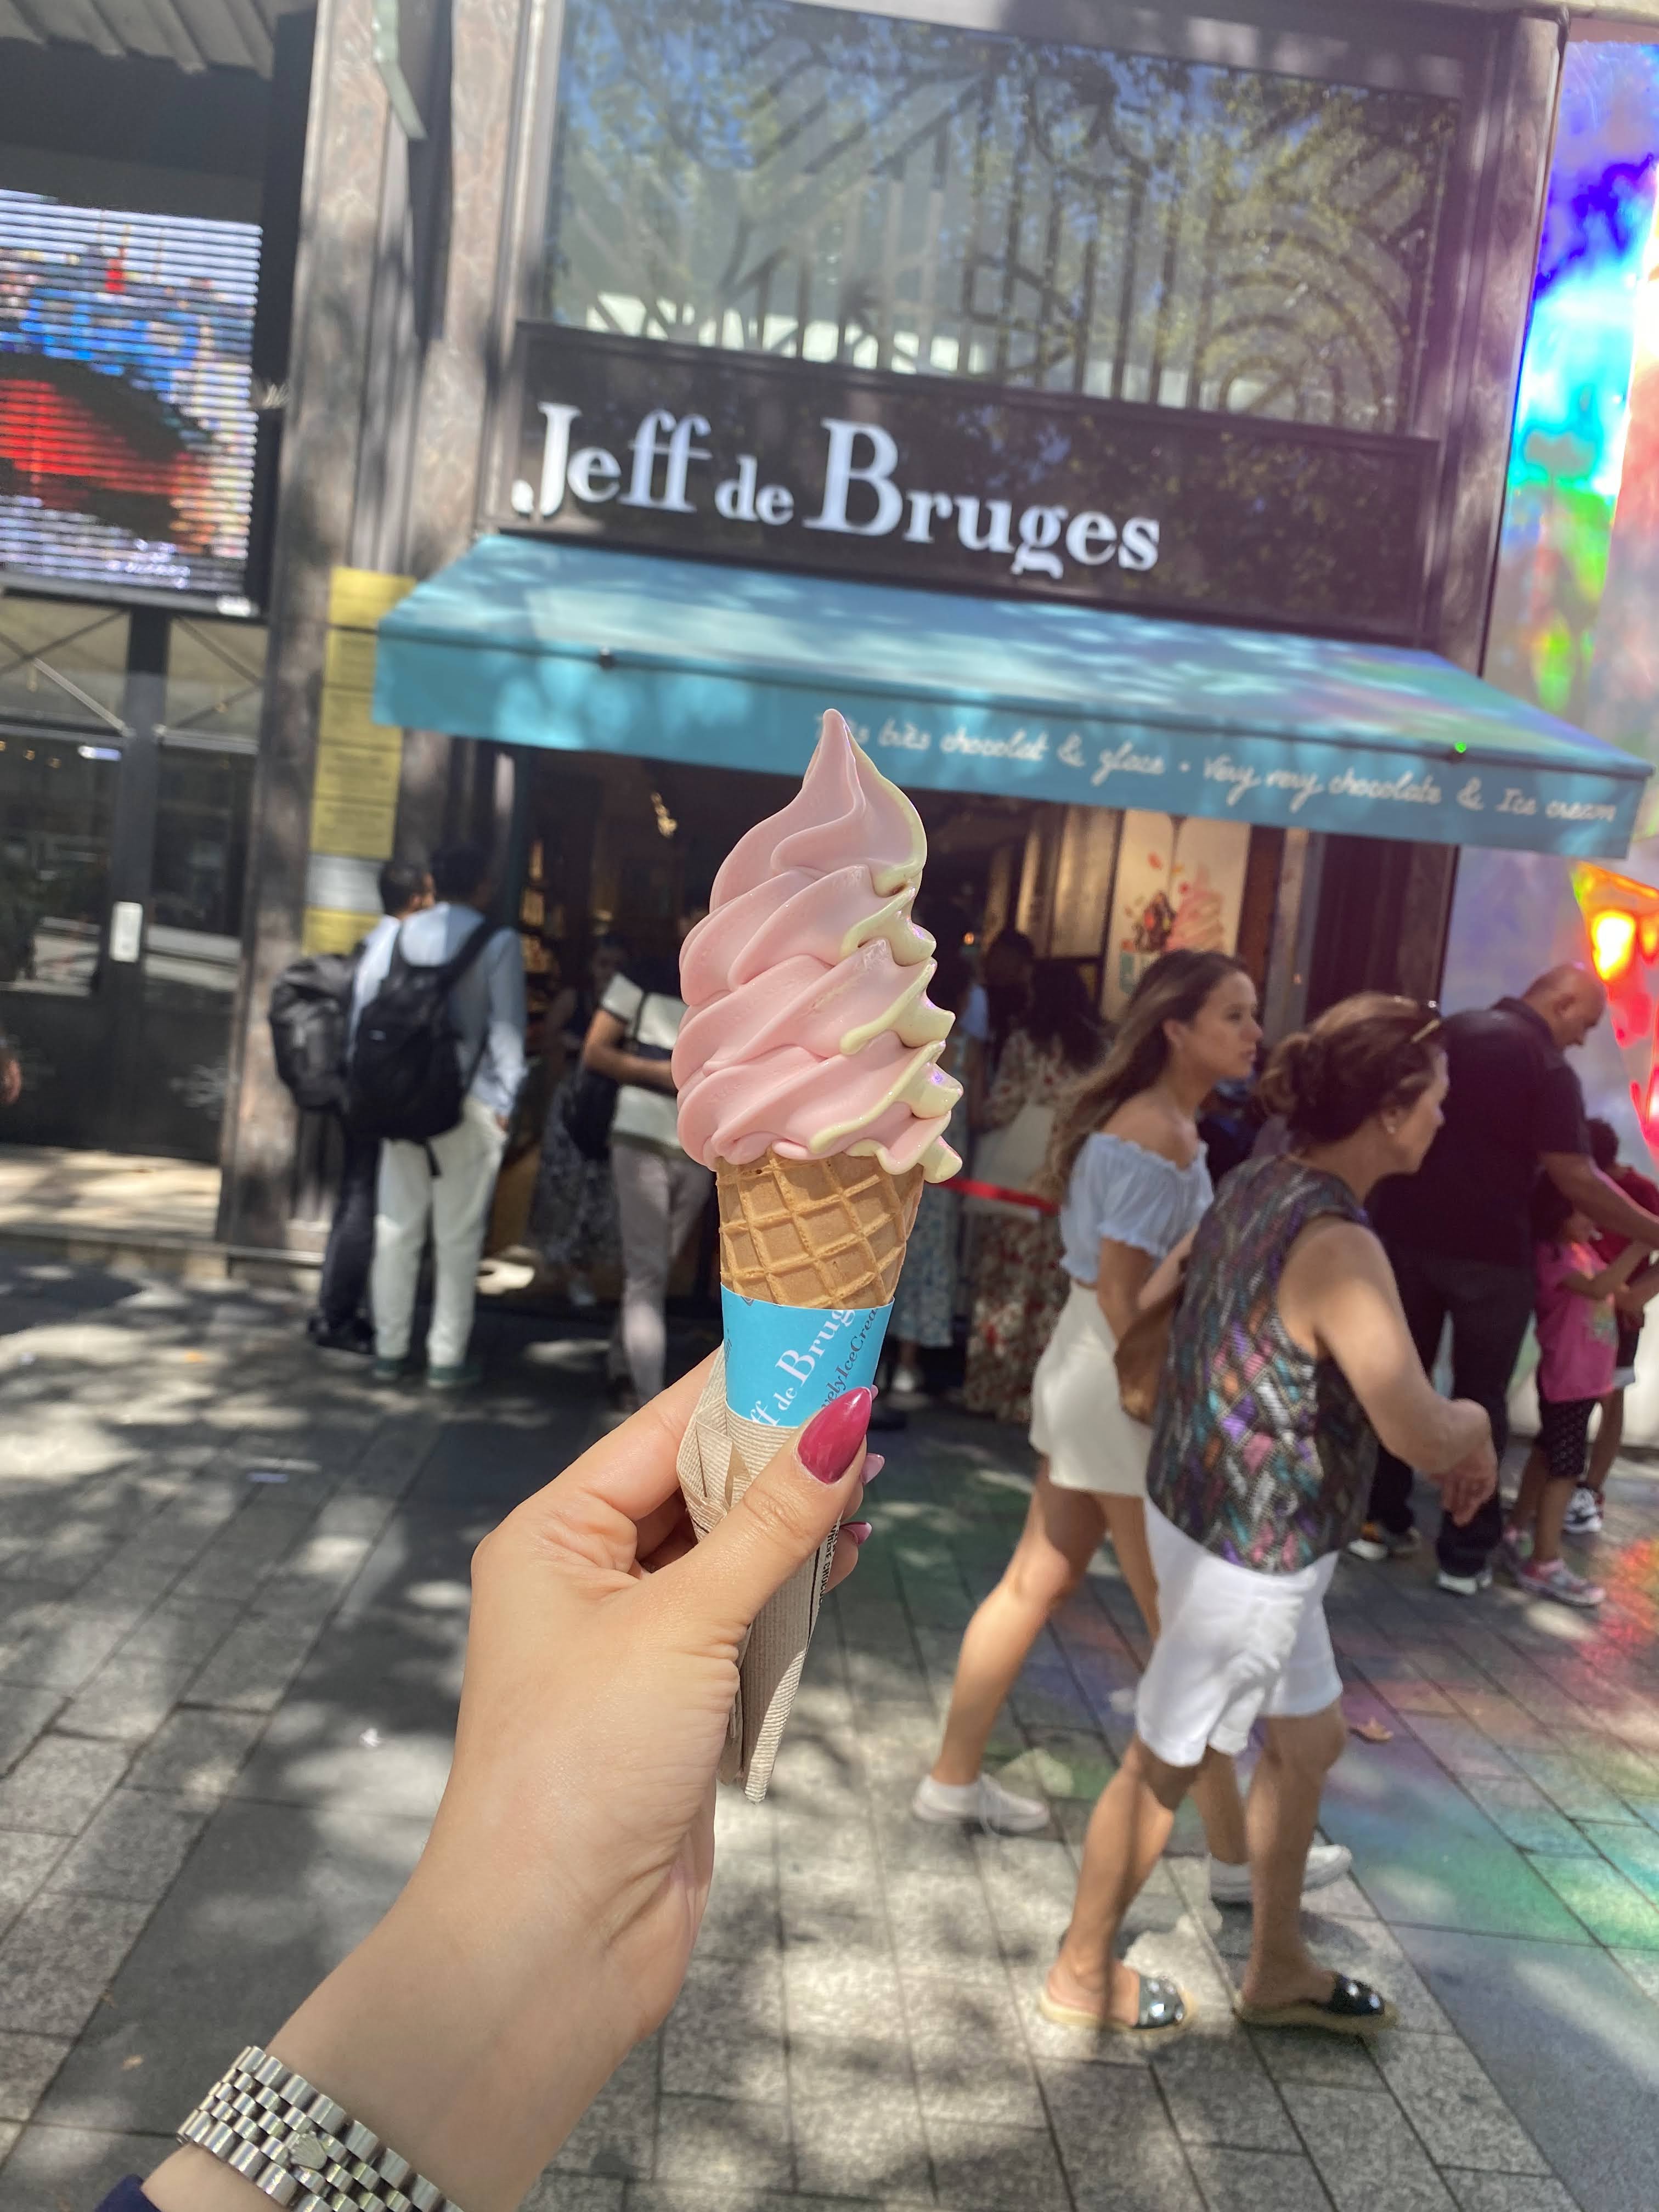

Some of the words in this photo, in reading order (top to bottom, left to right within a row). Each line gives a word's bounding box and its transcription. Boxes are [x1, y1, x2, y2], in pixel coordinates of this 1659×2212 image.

[511, 401, 713, 516] Jeff
[714, 455, 794, 526] de
[803, 417, 1160, 579] Bruges
[940, 725, 1049, 761] chocolat
[1057, 732, 1086, 768] &
[1091, 741, 1165, 786] glace
[1329, 766, 1442, 805] chocolate
[1456, 776, 1485, 811] &
[1545, 799, 1616, 823] cream
[773, 1387, 798, 1410] de
